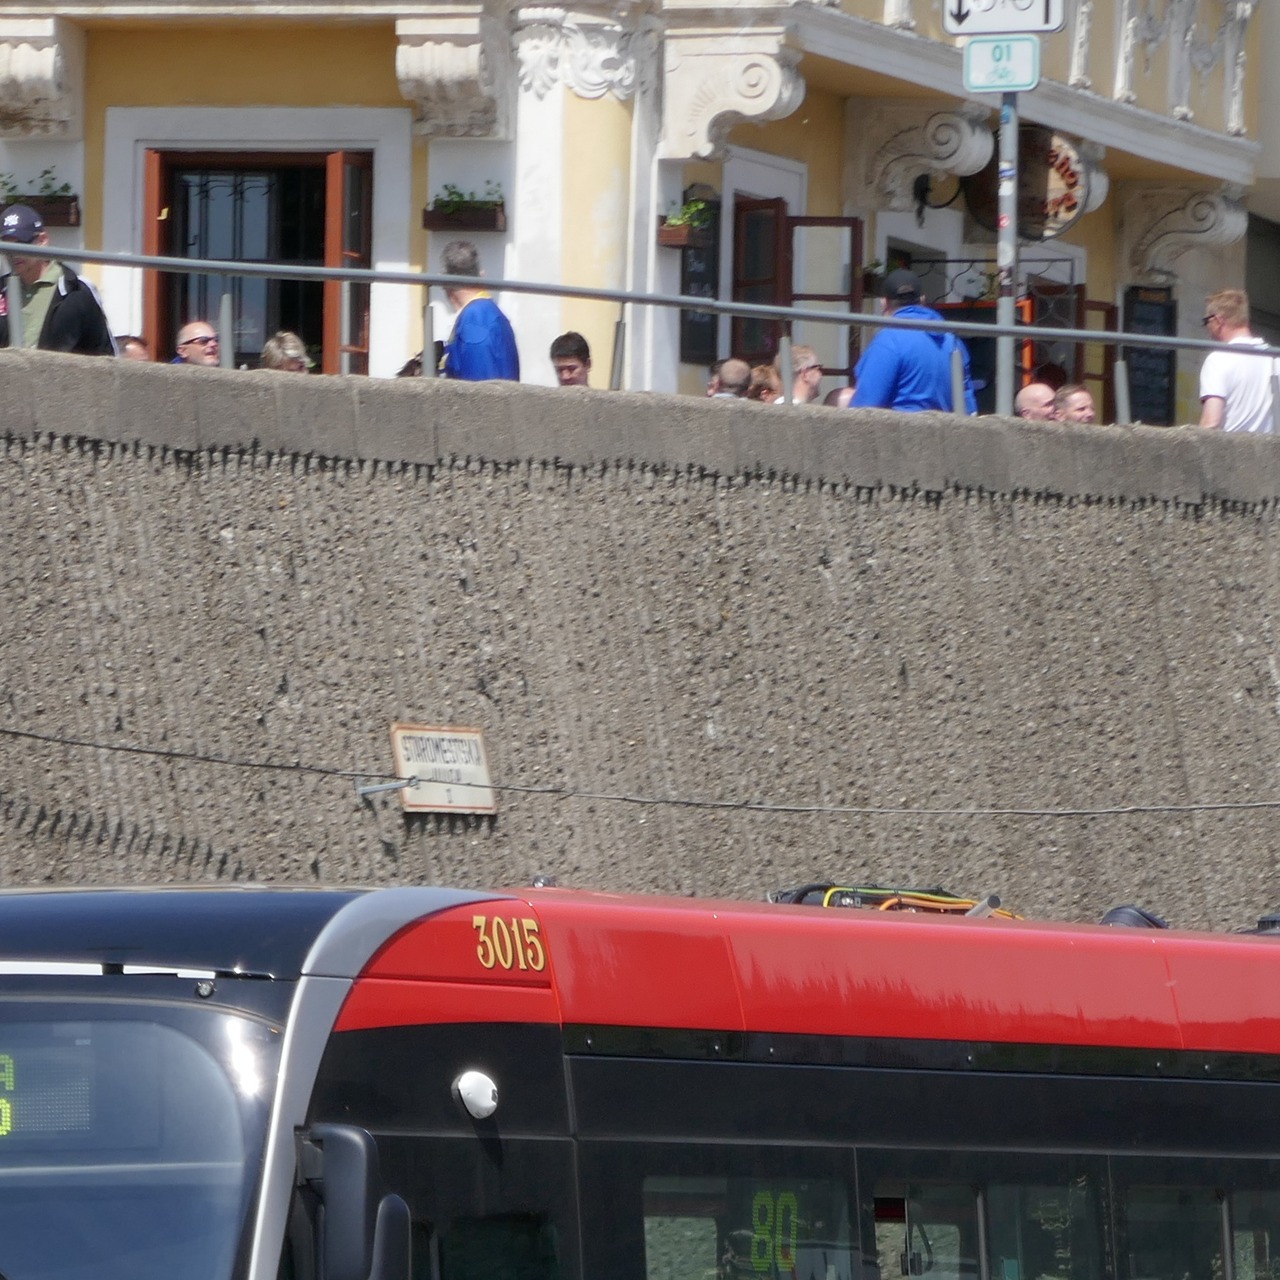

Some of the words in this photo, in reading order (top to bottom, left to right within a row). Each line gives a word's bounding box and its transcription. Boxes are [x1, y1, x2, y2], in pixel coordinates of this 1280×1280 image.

[991, 43, 1012, 63] 01
[472, 915, 545, 972] 3015
[751, 1191, 798, 1272] 80
